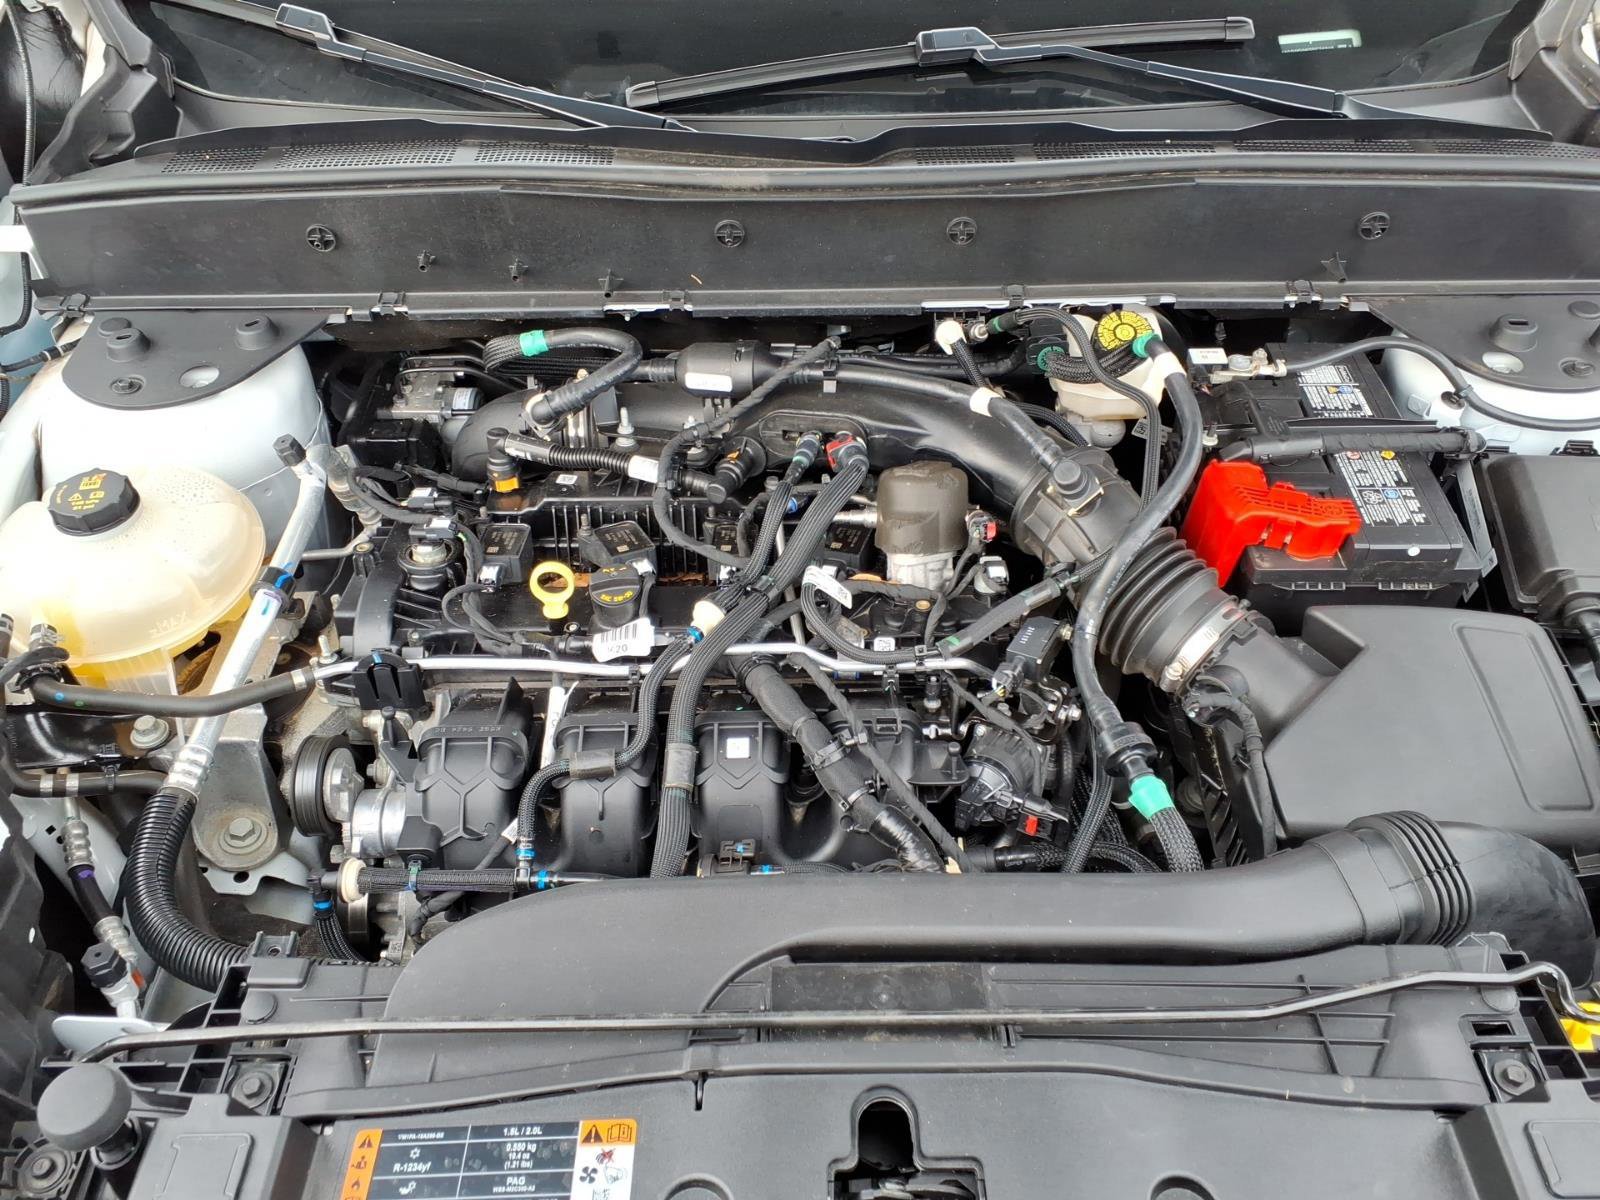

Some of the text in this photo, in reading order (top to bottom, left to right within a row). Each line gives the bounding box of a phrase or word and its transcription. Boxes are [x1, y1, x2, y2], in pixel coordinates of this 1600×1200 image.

[525, 1126, 543, 1135] 2.0L
[526, 1142, 537, 1152] kg
[393, 1161, 432, 1173] R-1234yf
[506, 1176, 526, 1186] PAG
